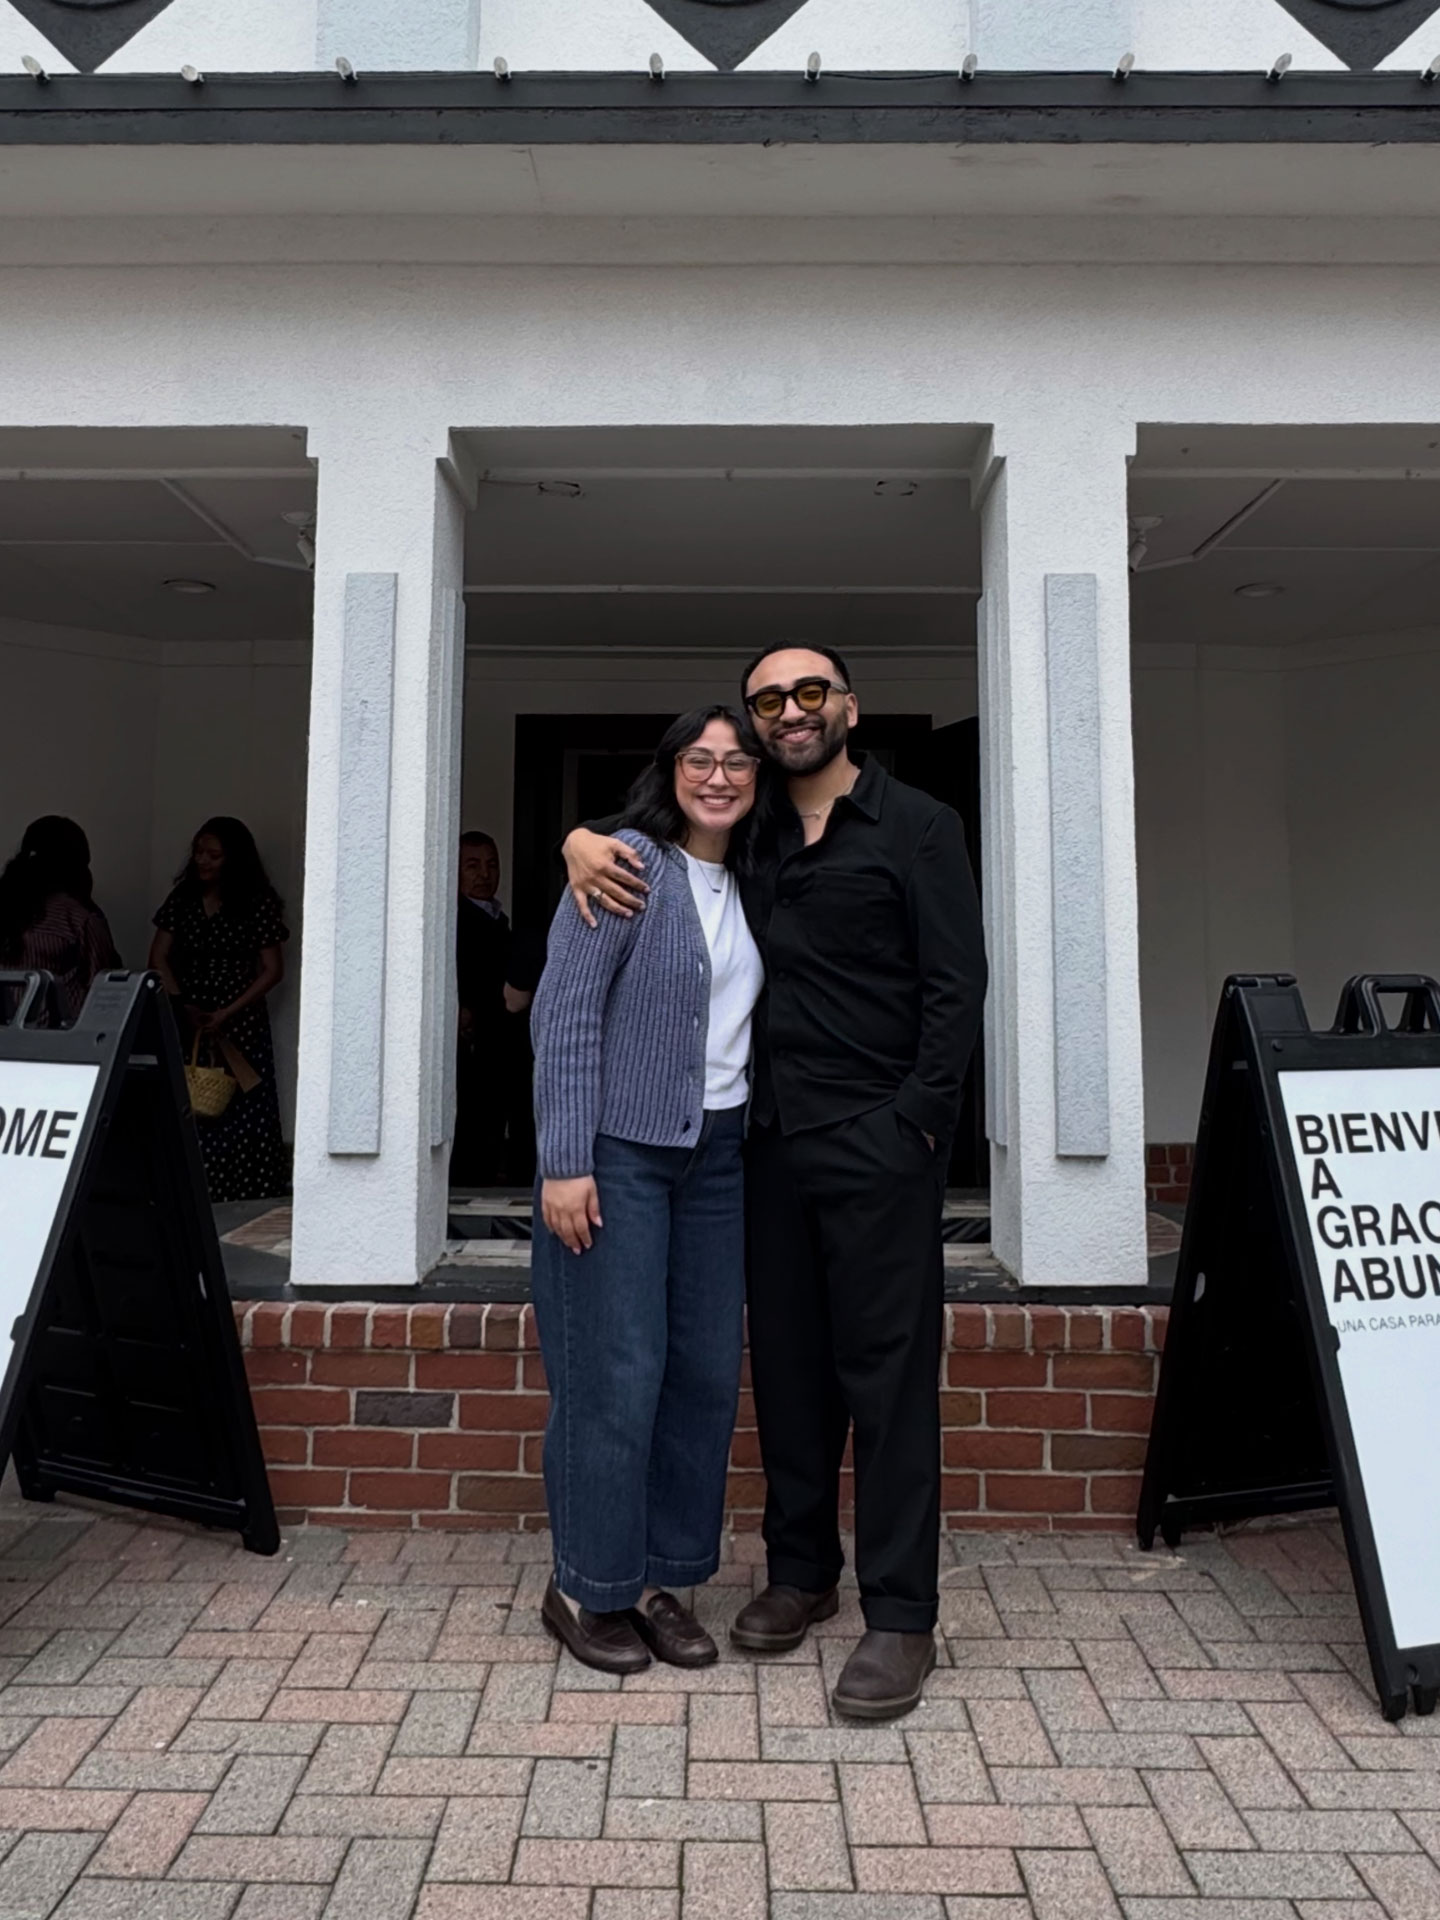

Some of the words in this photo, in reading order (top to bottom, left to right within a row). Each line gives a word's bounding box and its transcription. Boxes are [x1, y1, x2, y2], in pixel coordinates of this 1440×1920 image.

[0, 1106, 78, 1159] ME
[1311, 1157, 1343, 1200] A
[1337, 1318, 1366, 1333] UNA
[1369, 1315, 1406, 1331] CASA
